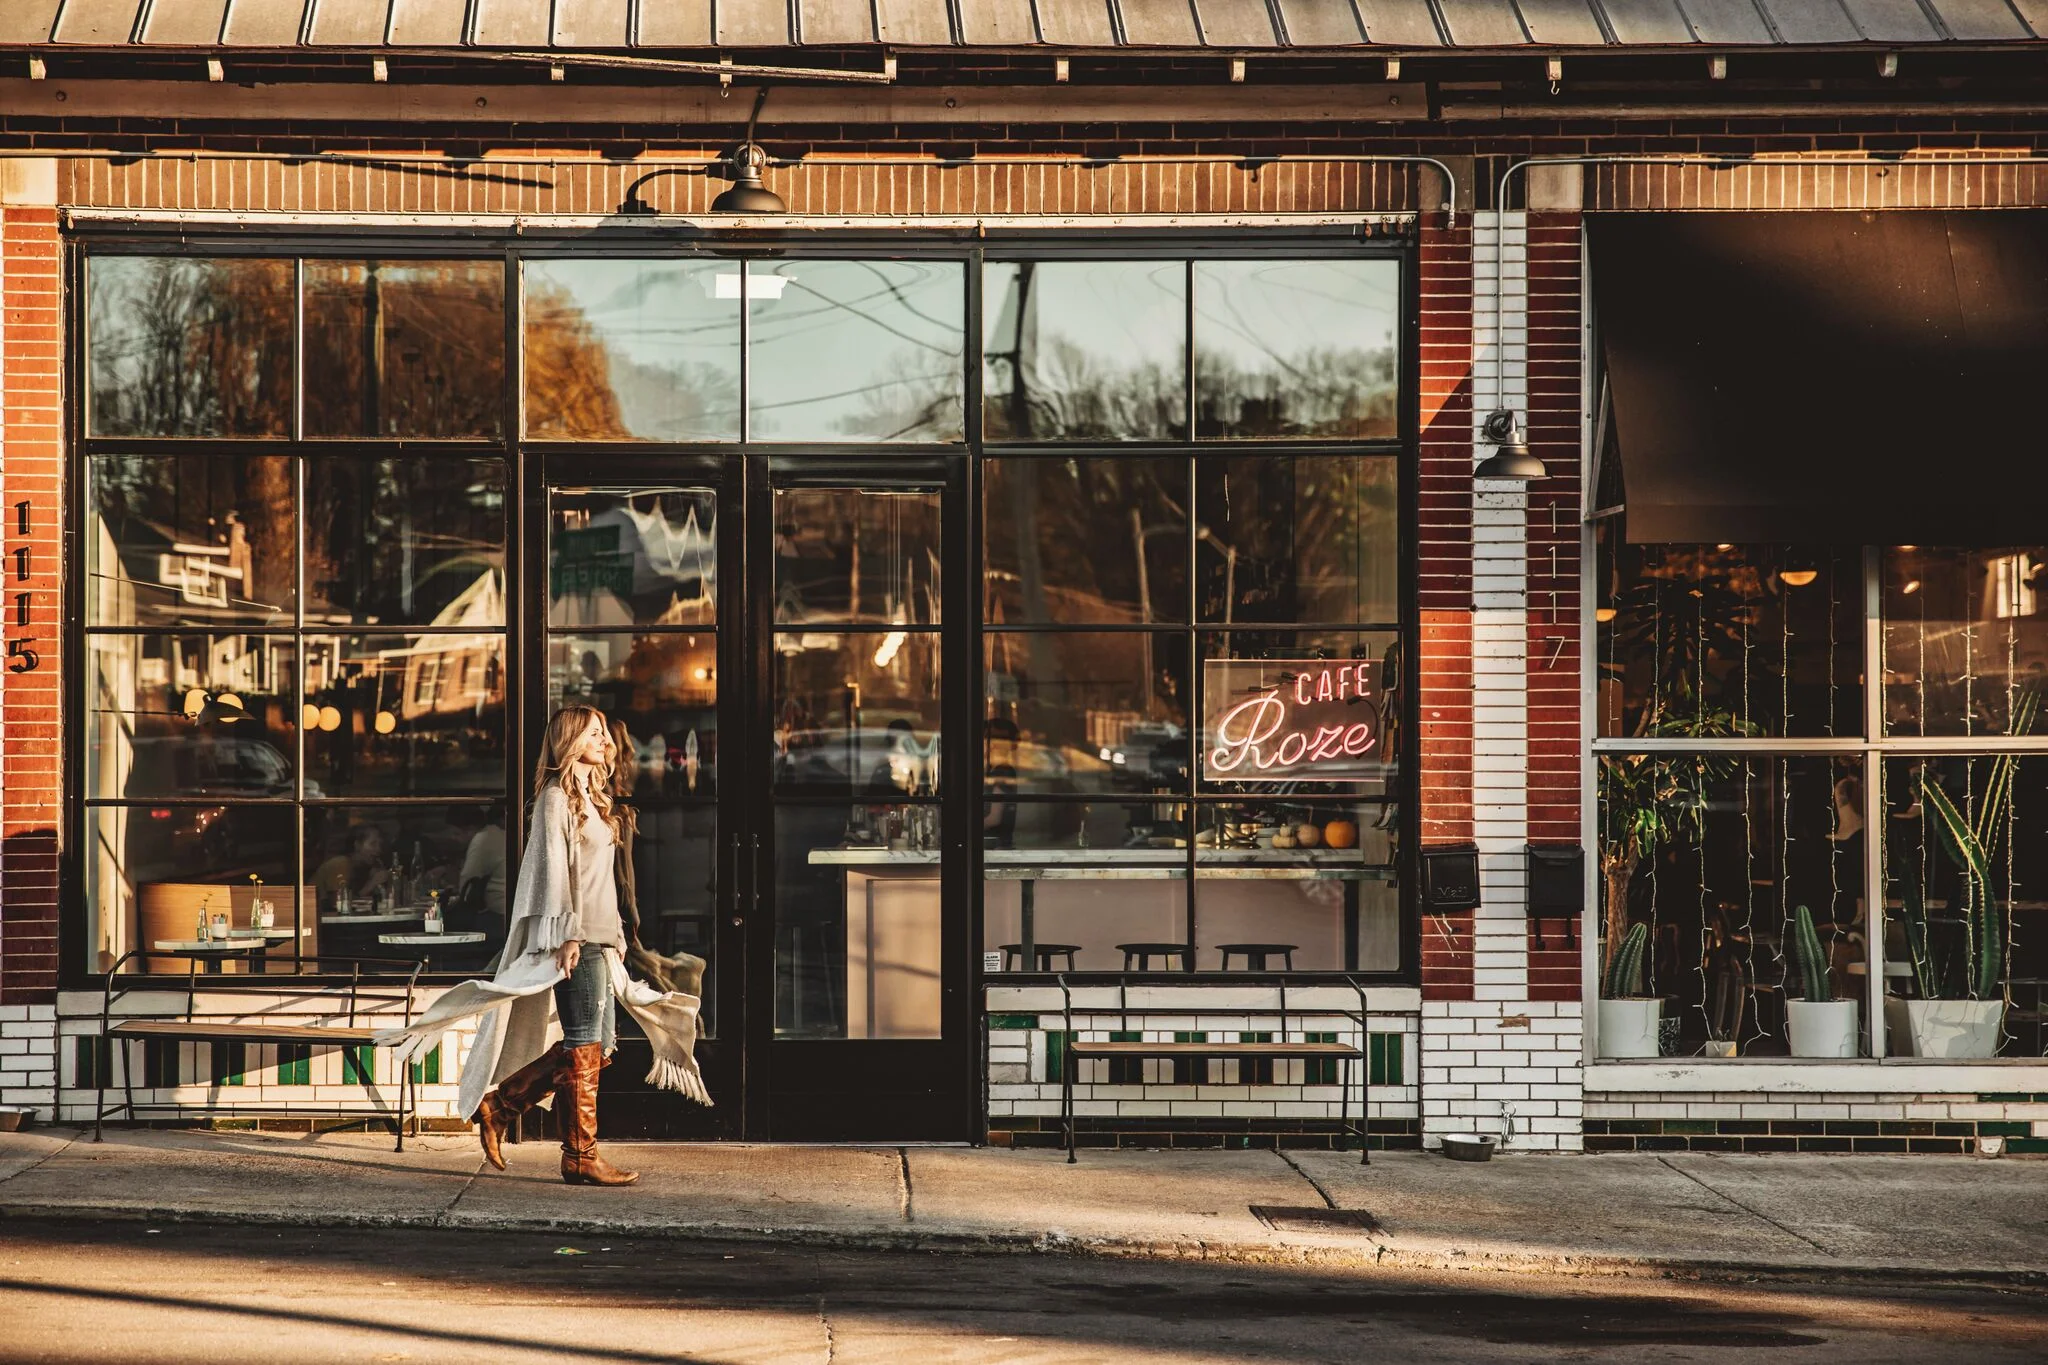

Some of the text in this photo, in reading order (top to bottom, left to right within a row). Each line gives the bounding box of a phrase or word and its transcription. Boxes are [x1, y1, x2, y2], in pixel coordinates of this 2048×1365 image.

[9, 500, 39, 673] 1115
[1546, 500, 1566, 669] 1117
[1210, 689, 1376, 772] Roze
[1295, 663, 1371, 705] CAFE
